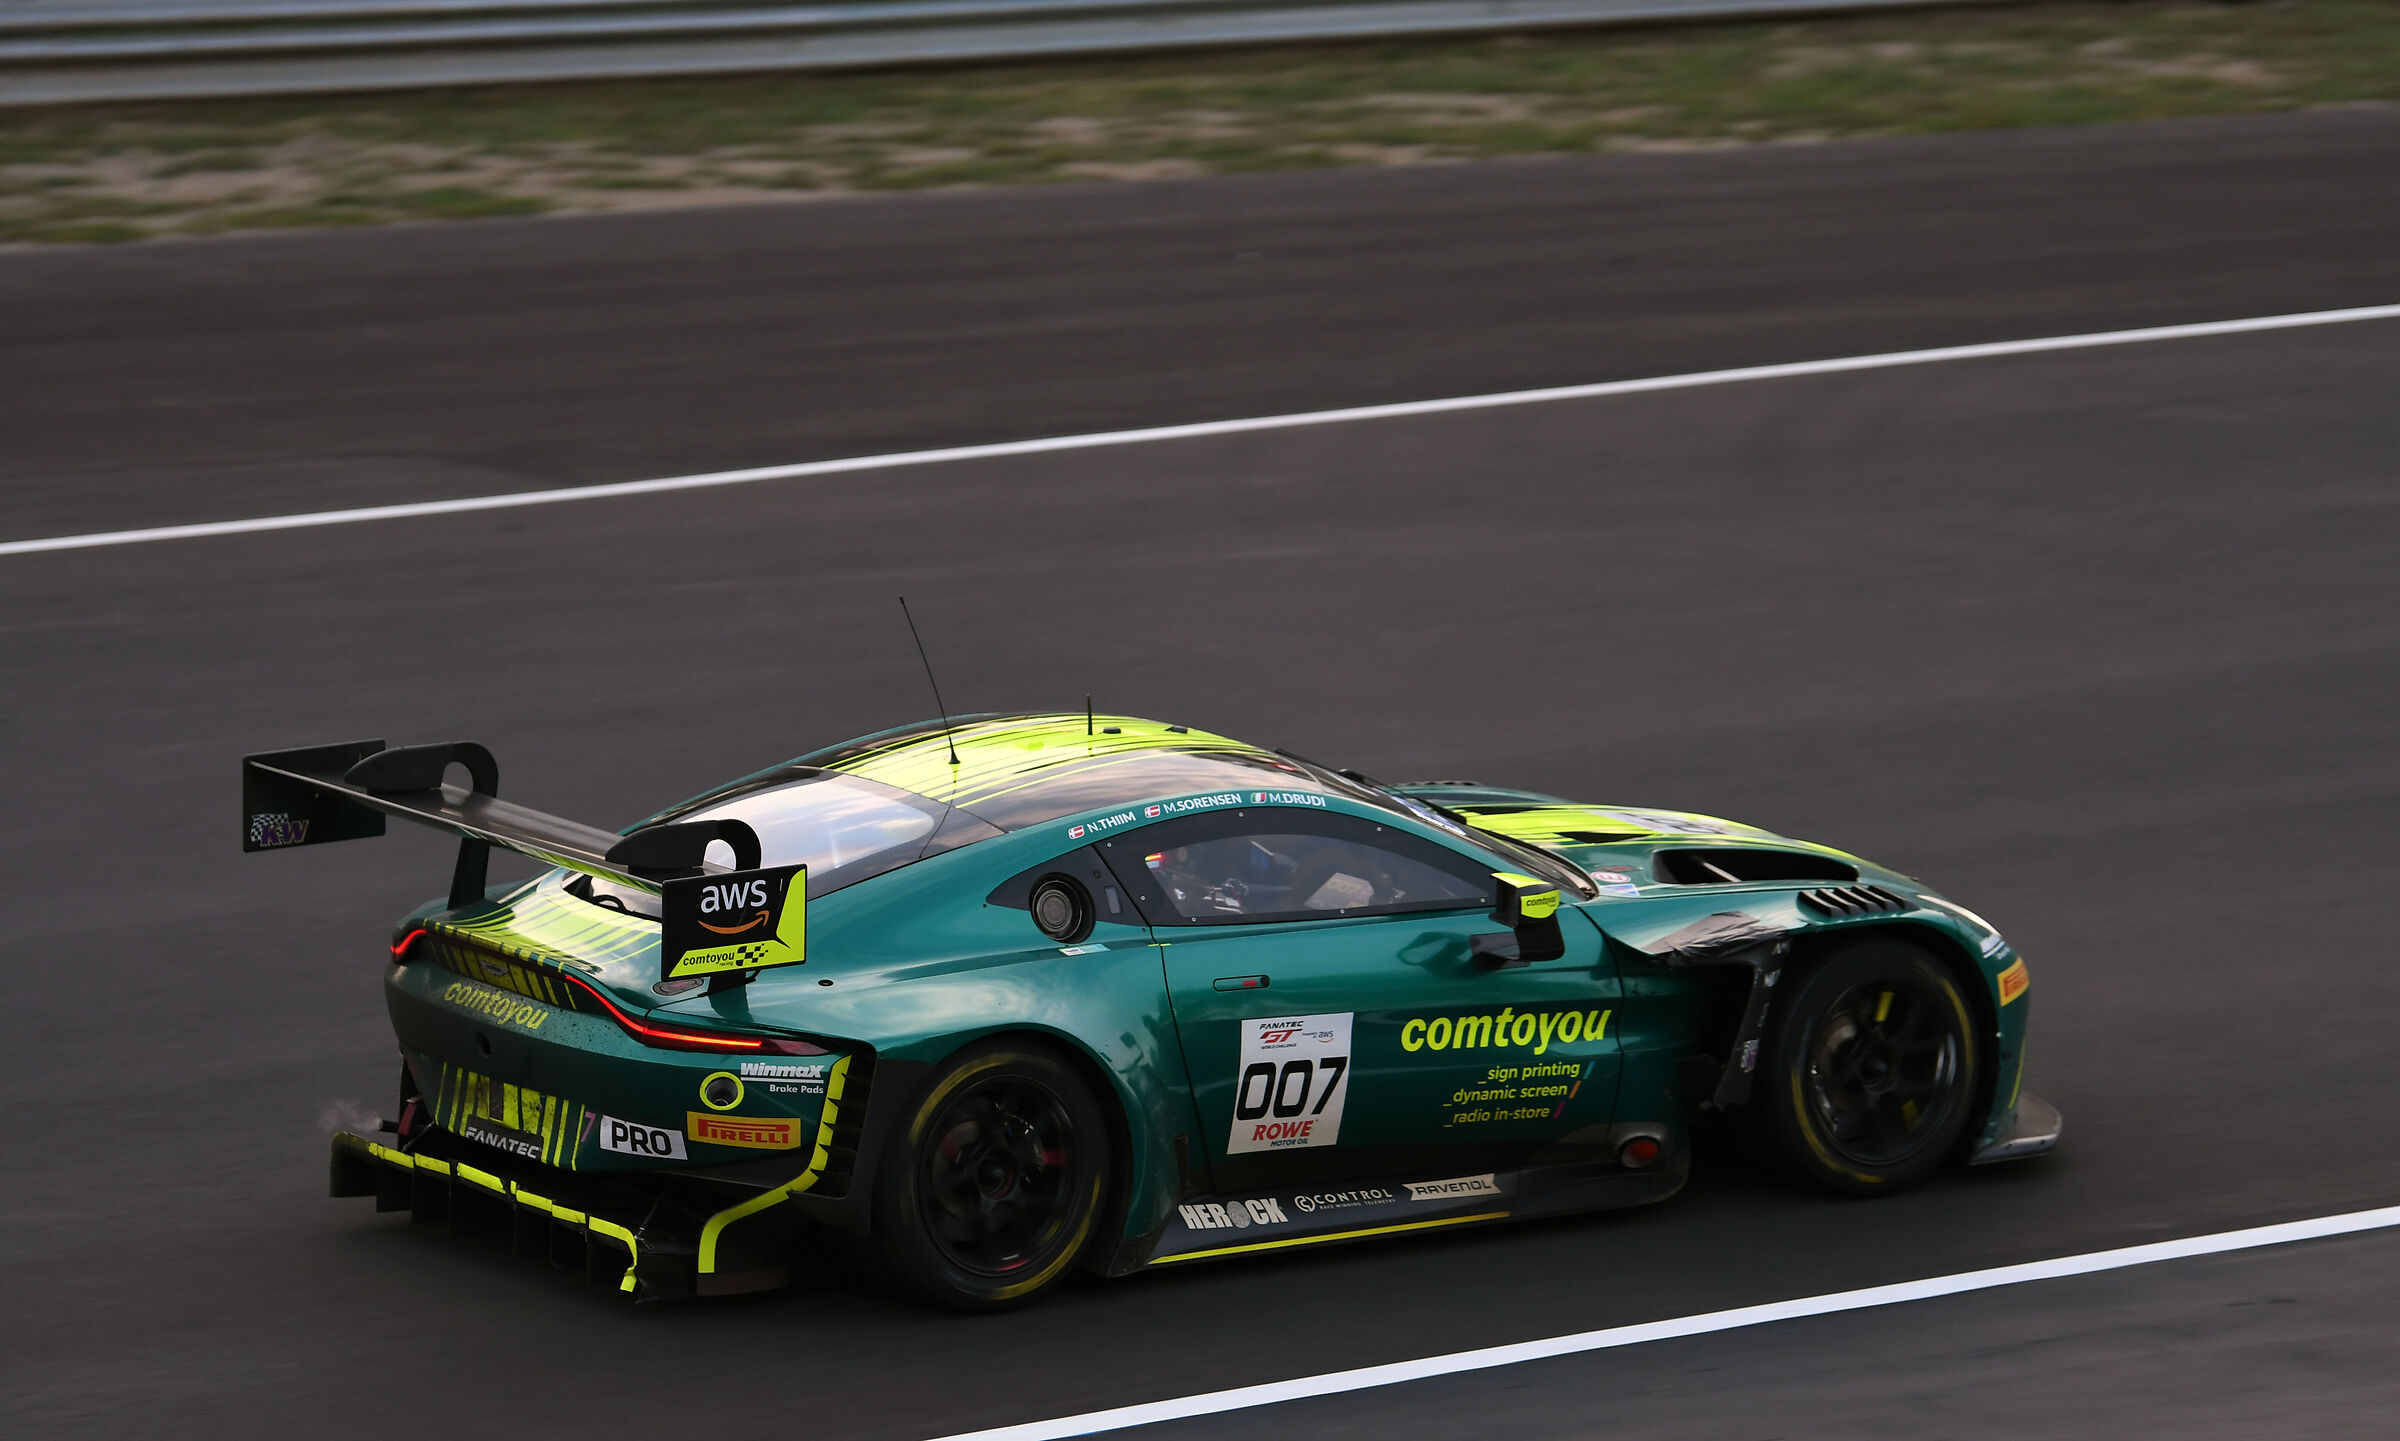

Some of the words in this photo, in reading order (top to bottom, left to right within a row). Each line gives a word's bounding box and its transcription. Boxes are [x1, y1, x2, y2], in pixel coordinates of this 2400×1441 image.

[1163, 793, 1242, 814] M.SORENSEN
[1270, 793, 1326, 807] M.DRUDI
[1087, 811, 1136, 833] N.THIIM
[260, 820, 310, 847] KW
[701, 880, 767, 914] aws
[683, 952, 735, 967] comtoyou
[444, 982, 549, 1030] comtoyou
[1260, 1020, 1304, 1030] FANATEC
[1401, 1007, 1612, 1056] comtoyou
[1260, 1028, 1303, 1044] GT
[1521, 1062, 1580, 1081] printing
[769, 1084, 798, 1093] Brake
[800, 1085, 824, 1094] Pads
[1236, 1056, 1348, 1121] 007
[1519, 1085, 1568, 1098] screen
[1494, 1107, 1550, 1121] in-store
[611, 1120, 672, 1156] PRO
[697, 1118, 790, 1145] PIRELLI
[1252, 1120, 1314, 1141] ROWE
[465, 1126, 541, 1159] FANATEC
[1270, 1139, 1296, 1147] MOTOR
[1313, 1188, 1393, 1205] CONTROL
[1414, 1179, 1492, 1195] RAVENOL
